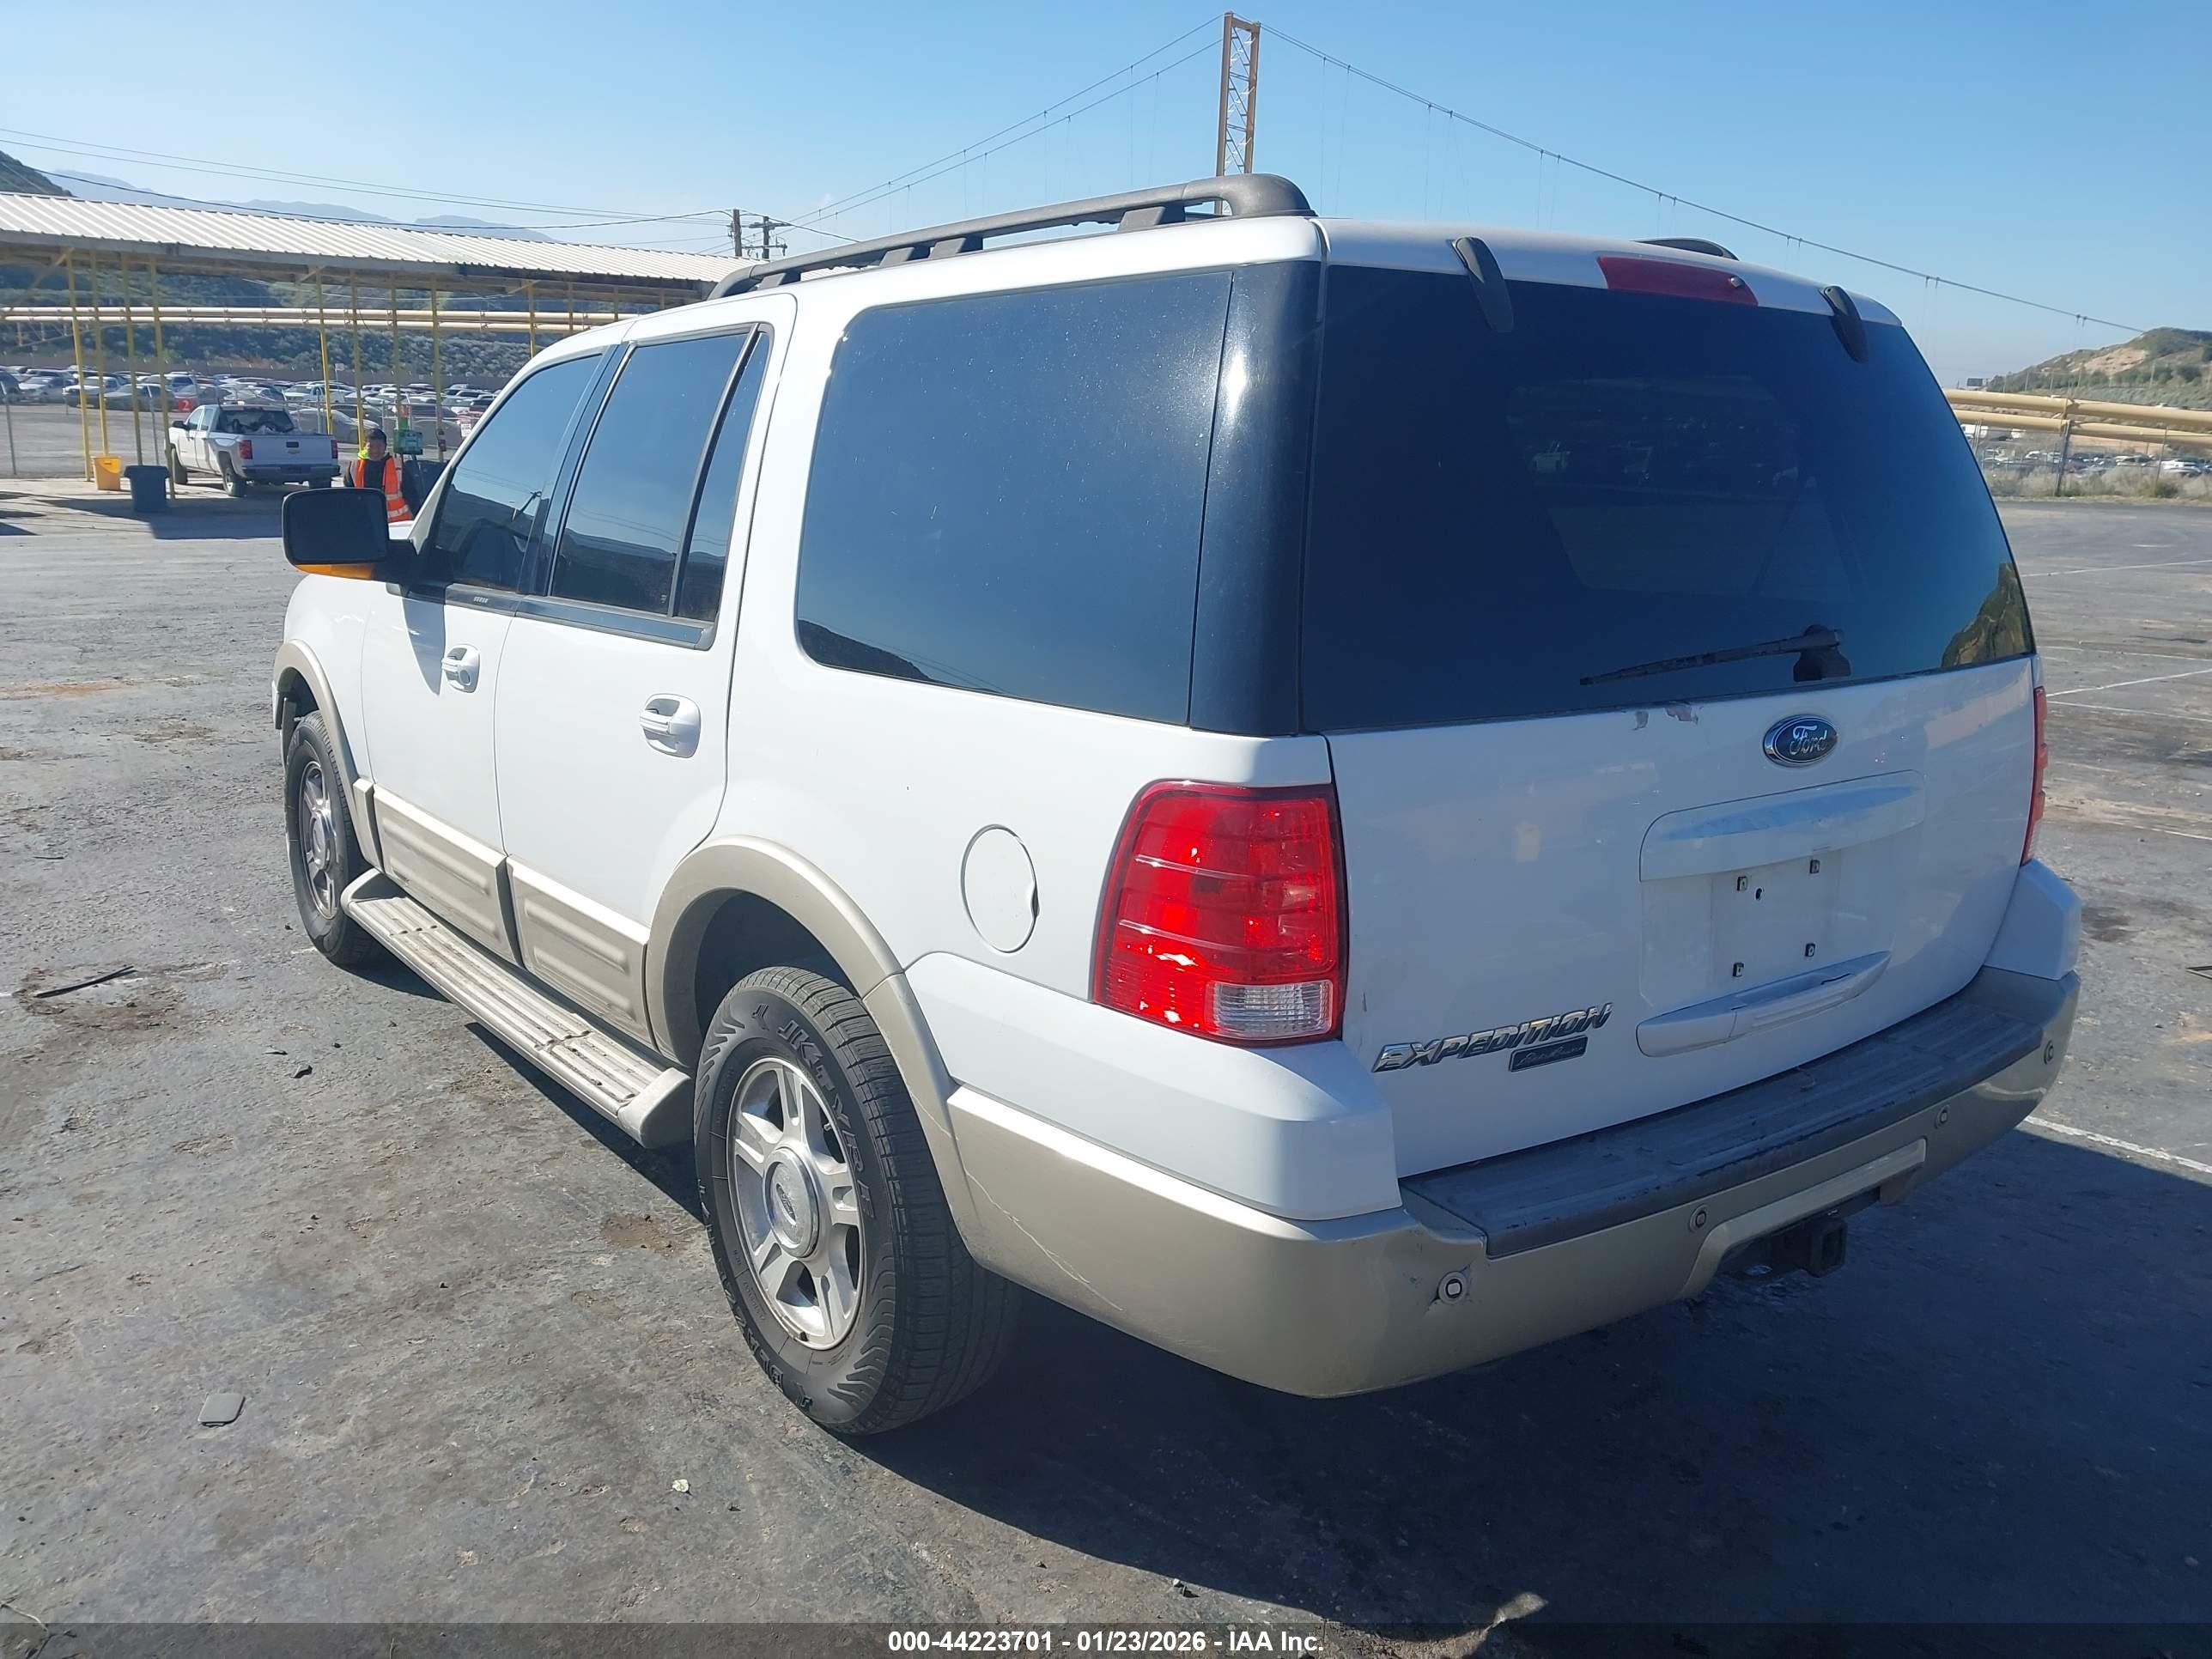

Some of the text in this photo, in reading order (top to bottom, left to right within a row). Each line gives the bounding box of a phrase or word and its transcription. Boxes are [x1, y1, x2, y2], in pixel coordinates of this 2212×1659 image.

[181, 398, 191, 411] 2
[1789, 725, 1828, 755] Ford
[1370, 1001, 1613, 1073] EXPEDITION
